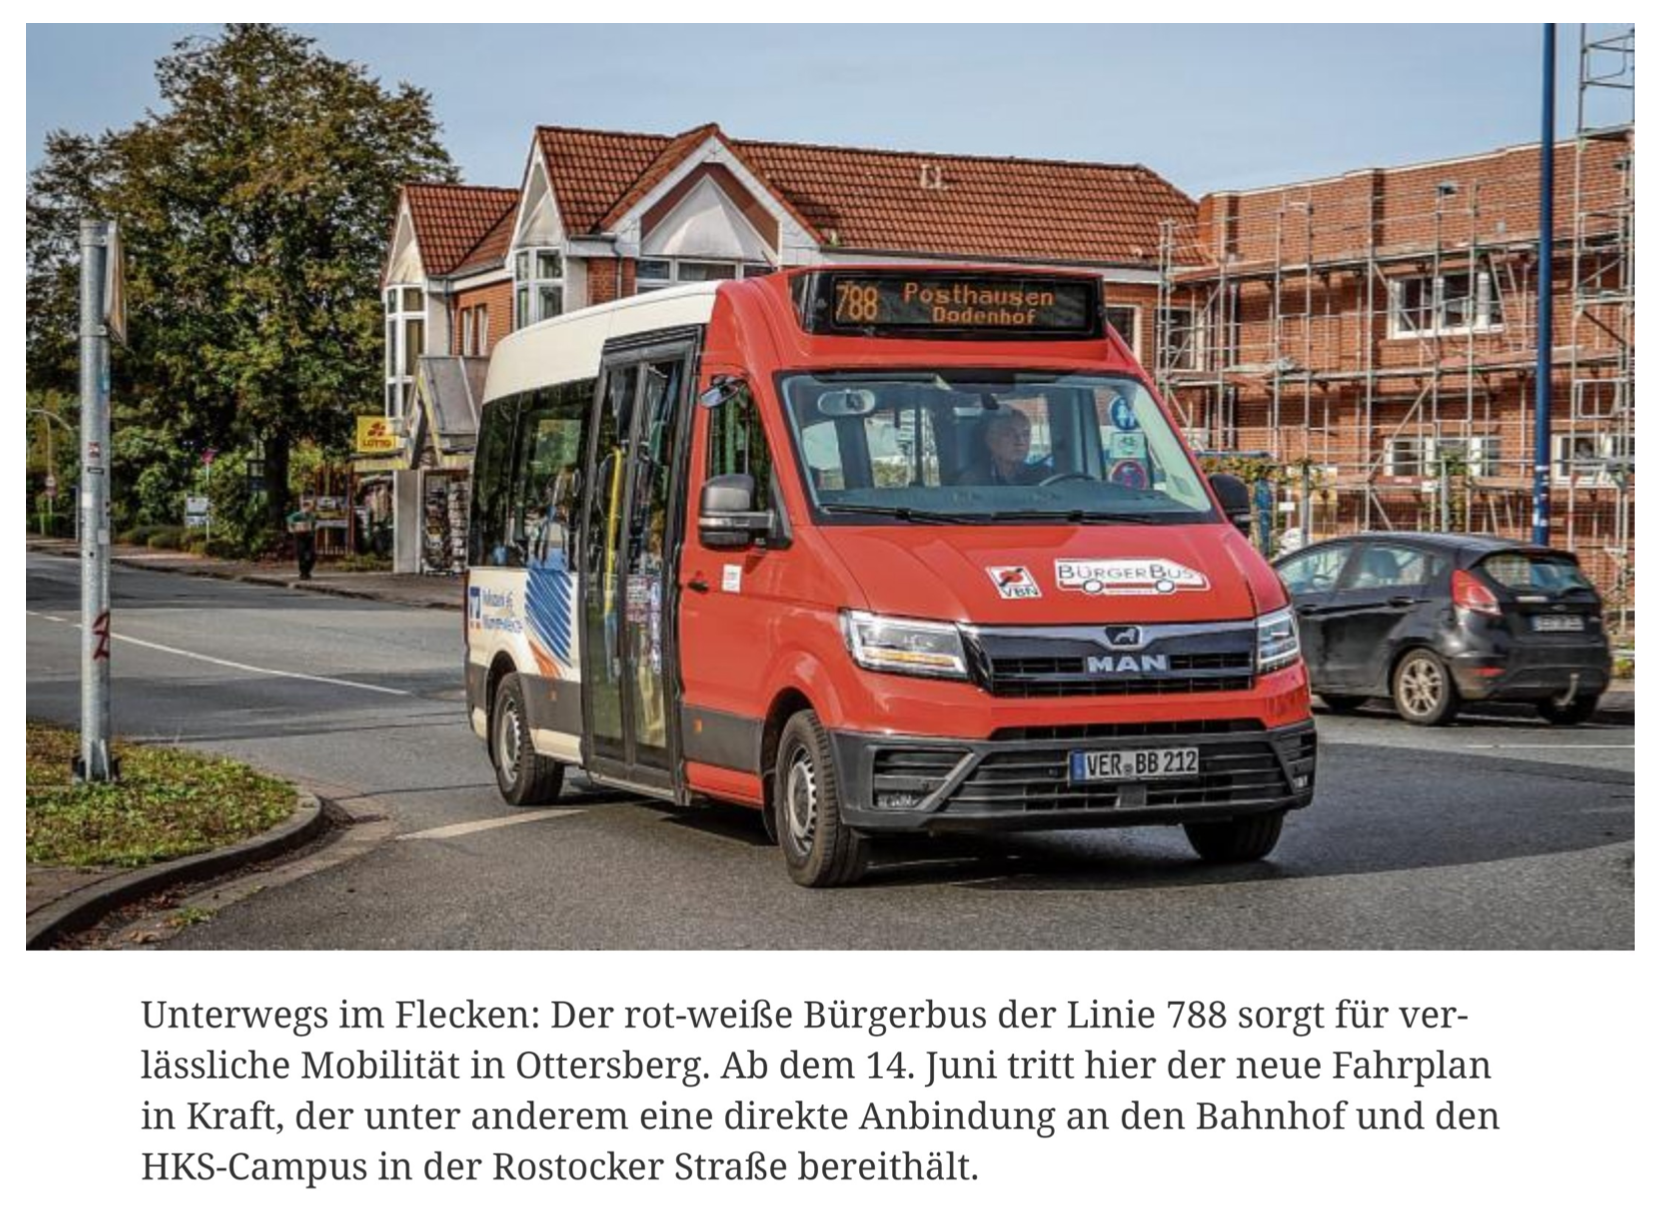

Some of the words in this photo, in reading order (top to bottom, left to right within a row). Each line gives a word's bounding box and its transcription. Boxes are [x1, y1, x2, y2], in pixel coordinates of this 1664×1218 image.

[836, 283, 879, 321] 788
[903, 281, 1056, 306] Posthausen
[932, 306, 1037, 325] Dodenhof
[362, 439, 392, 448] LOTTO
[1003, 586, 1038, 598] VBN
[1086, 653, 1168, 673] MAN
[1087, 752, 1122, 776] VER
[1135, 752, 1159, 774] BB
[1163, 750, 1197, 773] 212
